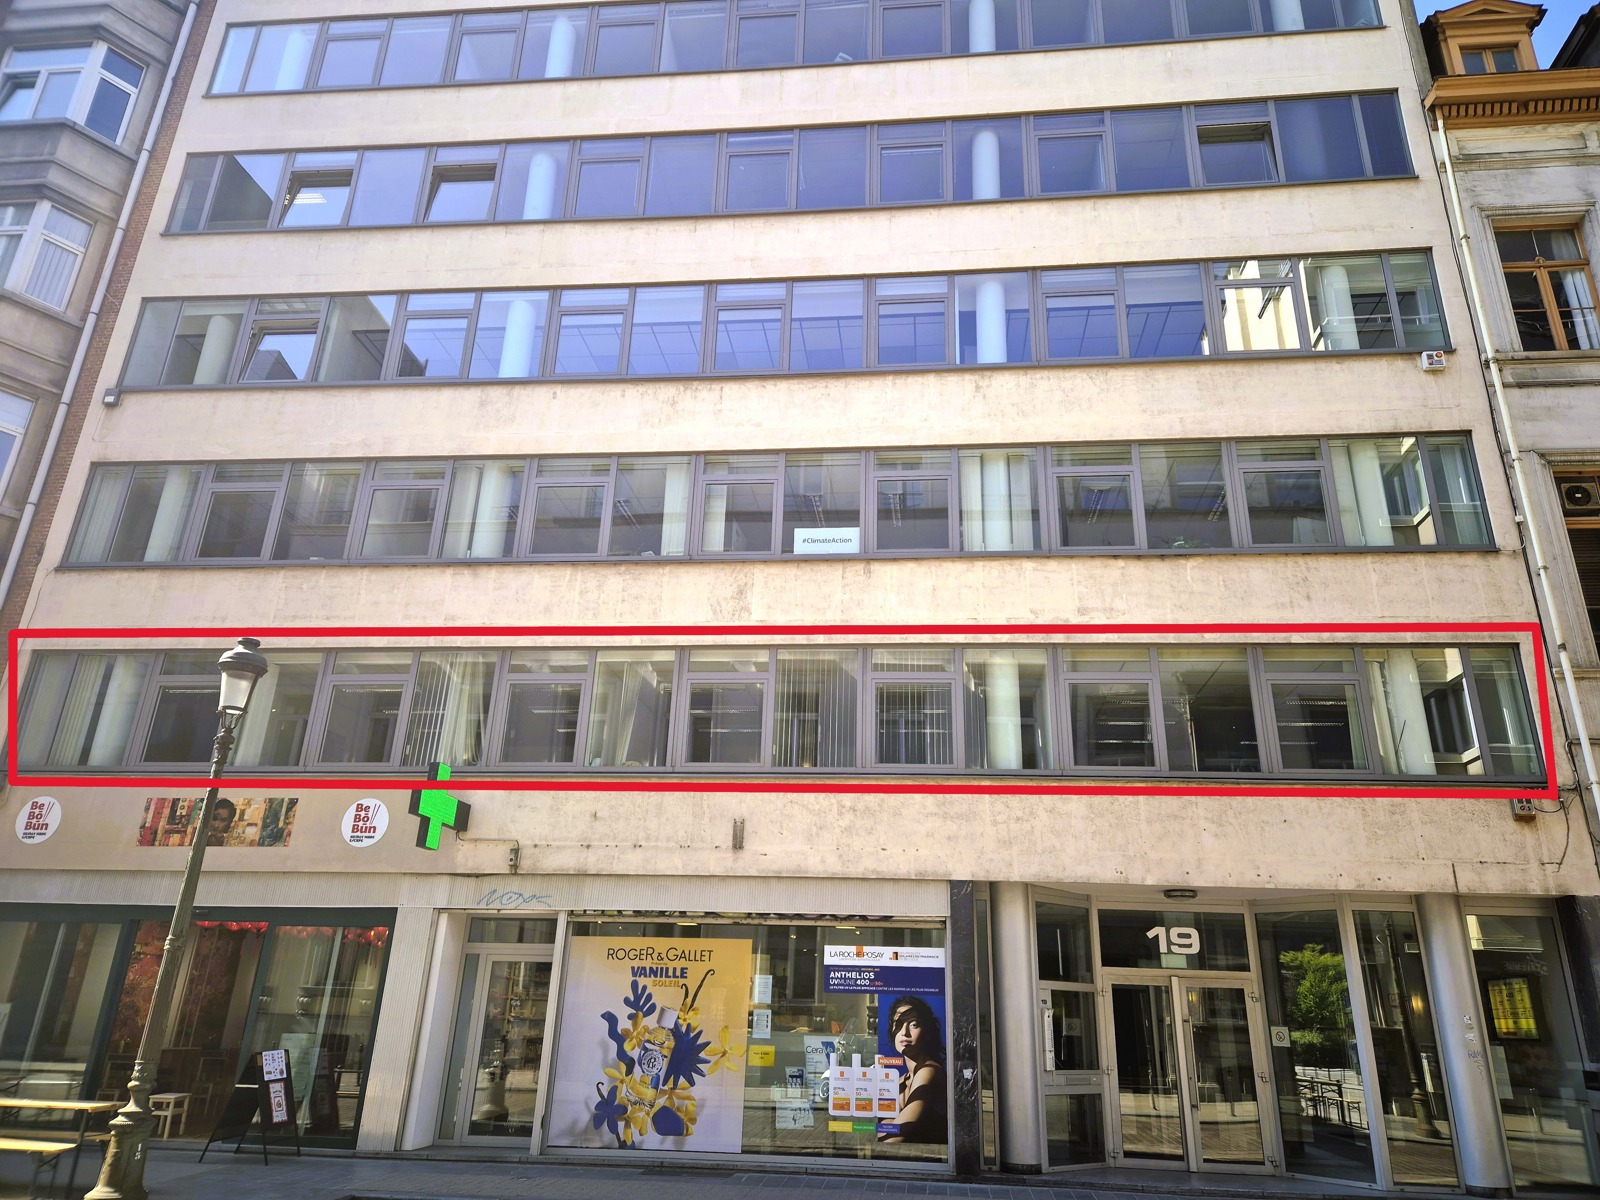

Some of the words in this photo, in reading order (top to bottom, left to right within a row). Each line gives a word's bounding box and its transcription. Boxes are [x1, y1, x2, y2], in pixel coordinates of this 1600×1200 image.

[30, 801, 45, 810] Be
[355, 803, 371, 812] Be
[1145, 926, 1200, 955] 19
[606, 946, 655, 961] ROGER
[656, 952, 665, 962] &
[666, 947, 714, 962] GALLET
[862, 951, 885, 959] POSAY
[630, 966, 688, 979] VANILLE
[829, 971, 875, 979] ANTHELIOS
[805, 1045, 834, 1054] CeraVe
